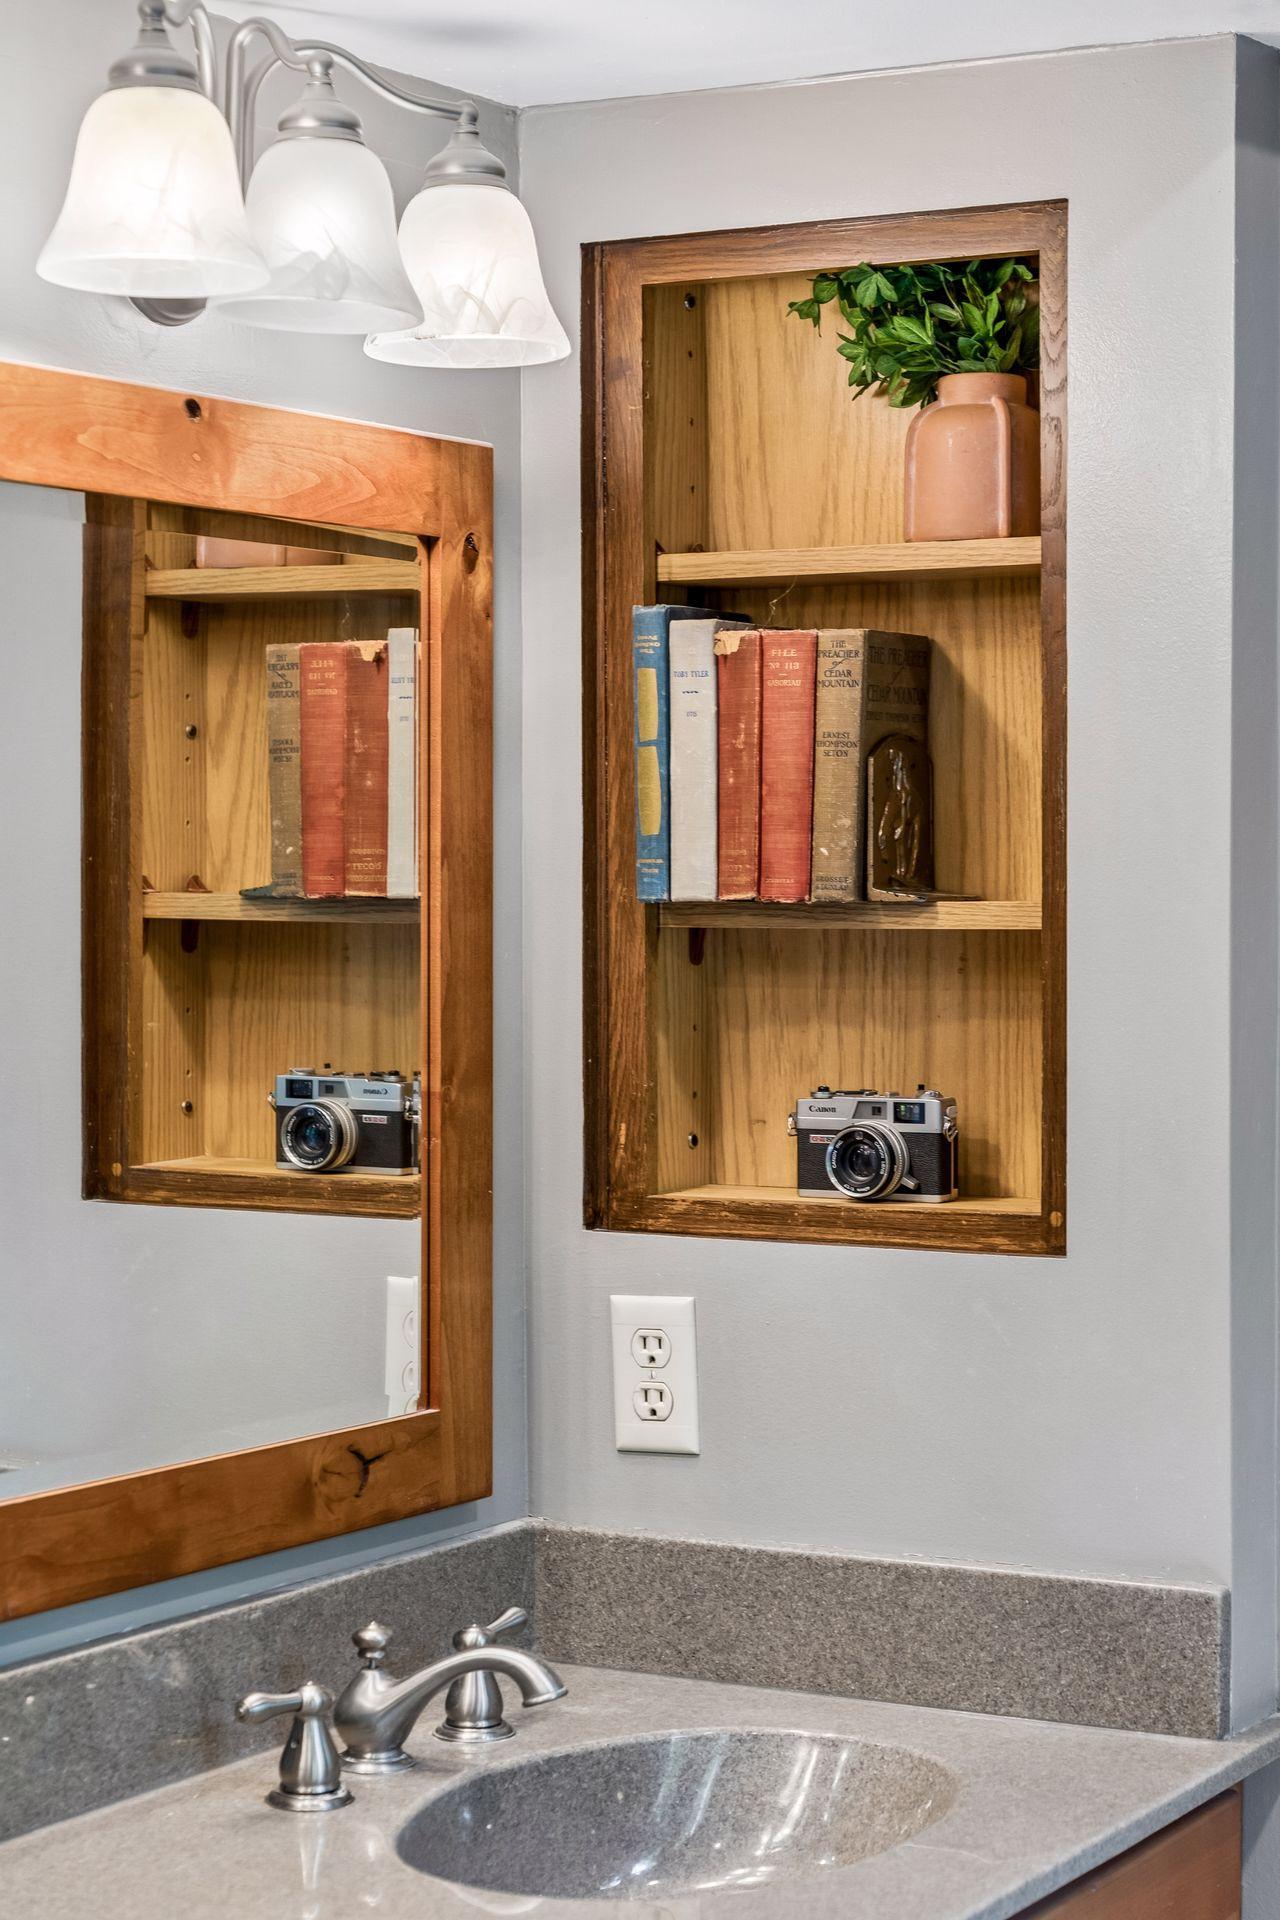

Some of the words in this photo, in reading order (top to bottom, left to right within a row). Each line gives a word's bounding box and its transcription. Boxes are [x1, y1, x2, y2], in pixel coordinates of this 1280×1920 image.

[818, 650, 860, 658] PREACHER
[824, 670, 852, 678] CEDAR
[818, 679, 860, 688] MOUNTAIN
[822, 732, 850, 740] ERNEST
[816, 740, 858, 748] THOMPSON
[823, 750, 849, 758] SETON
[808, 1105, 836, 1113] Canon
